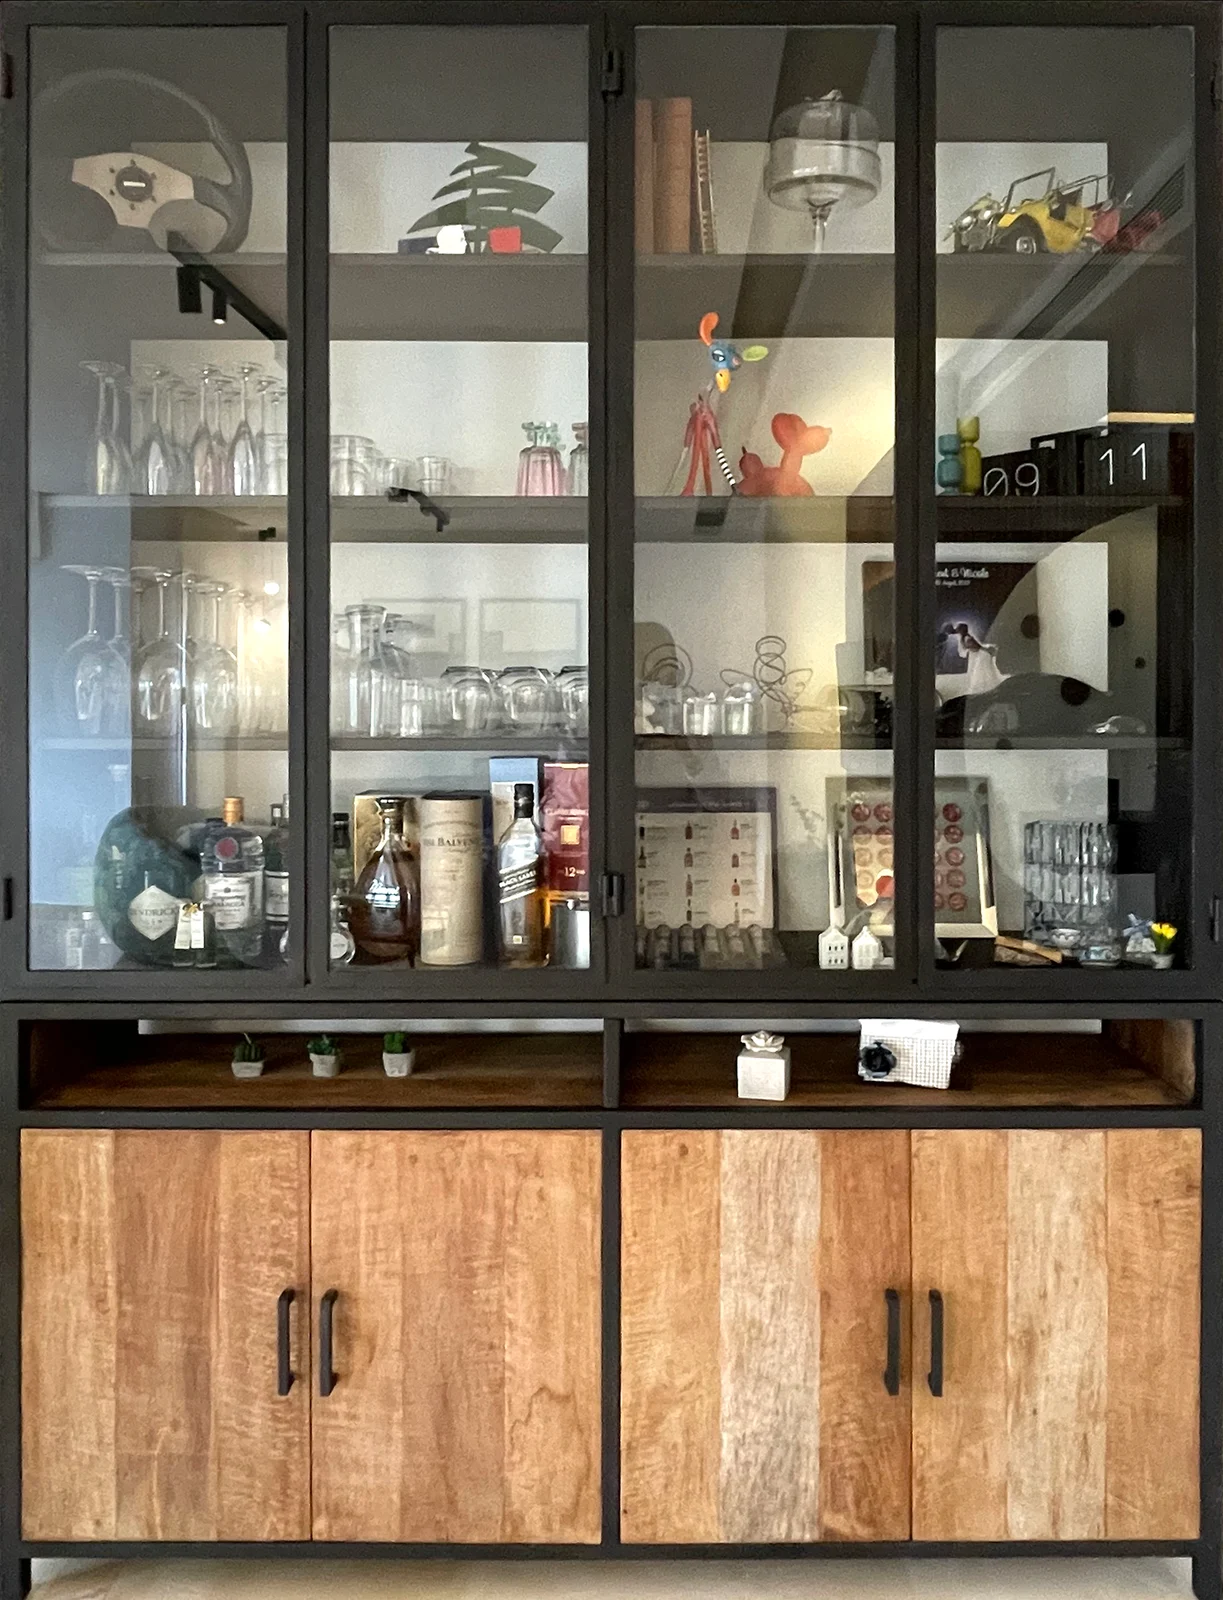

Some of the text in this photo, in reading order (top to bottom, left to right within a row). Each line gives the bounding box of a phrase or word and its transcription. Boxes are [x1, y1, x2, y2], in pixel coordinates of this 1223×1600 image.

[984, 443, 1146, 496] 09 11
[564, 867, 576, 878] 12
